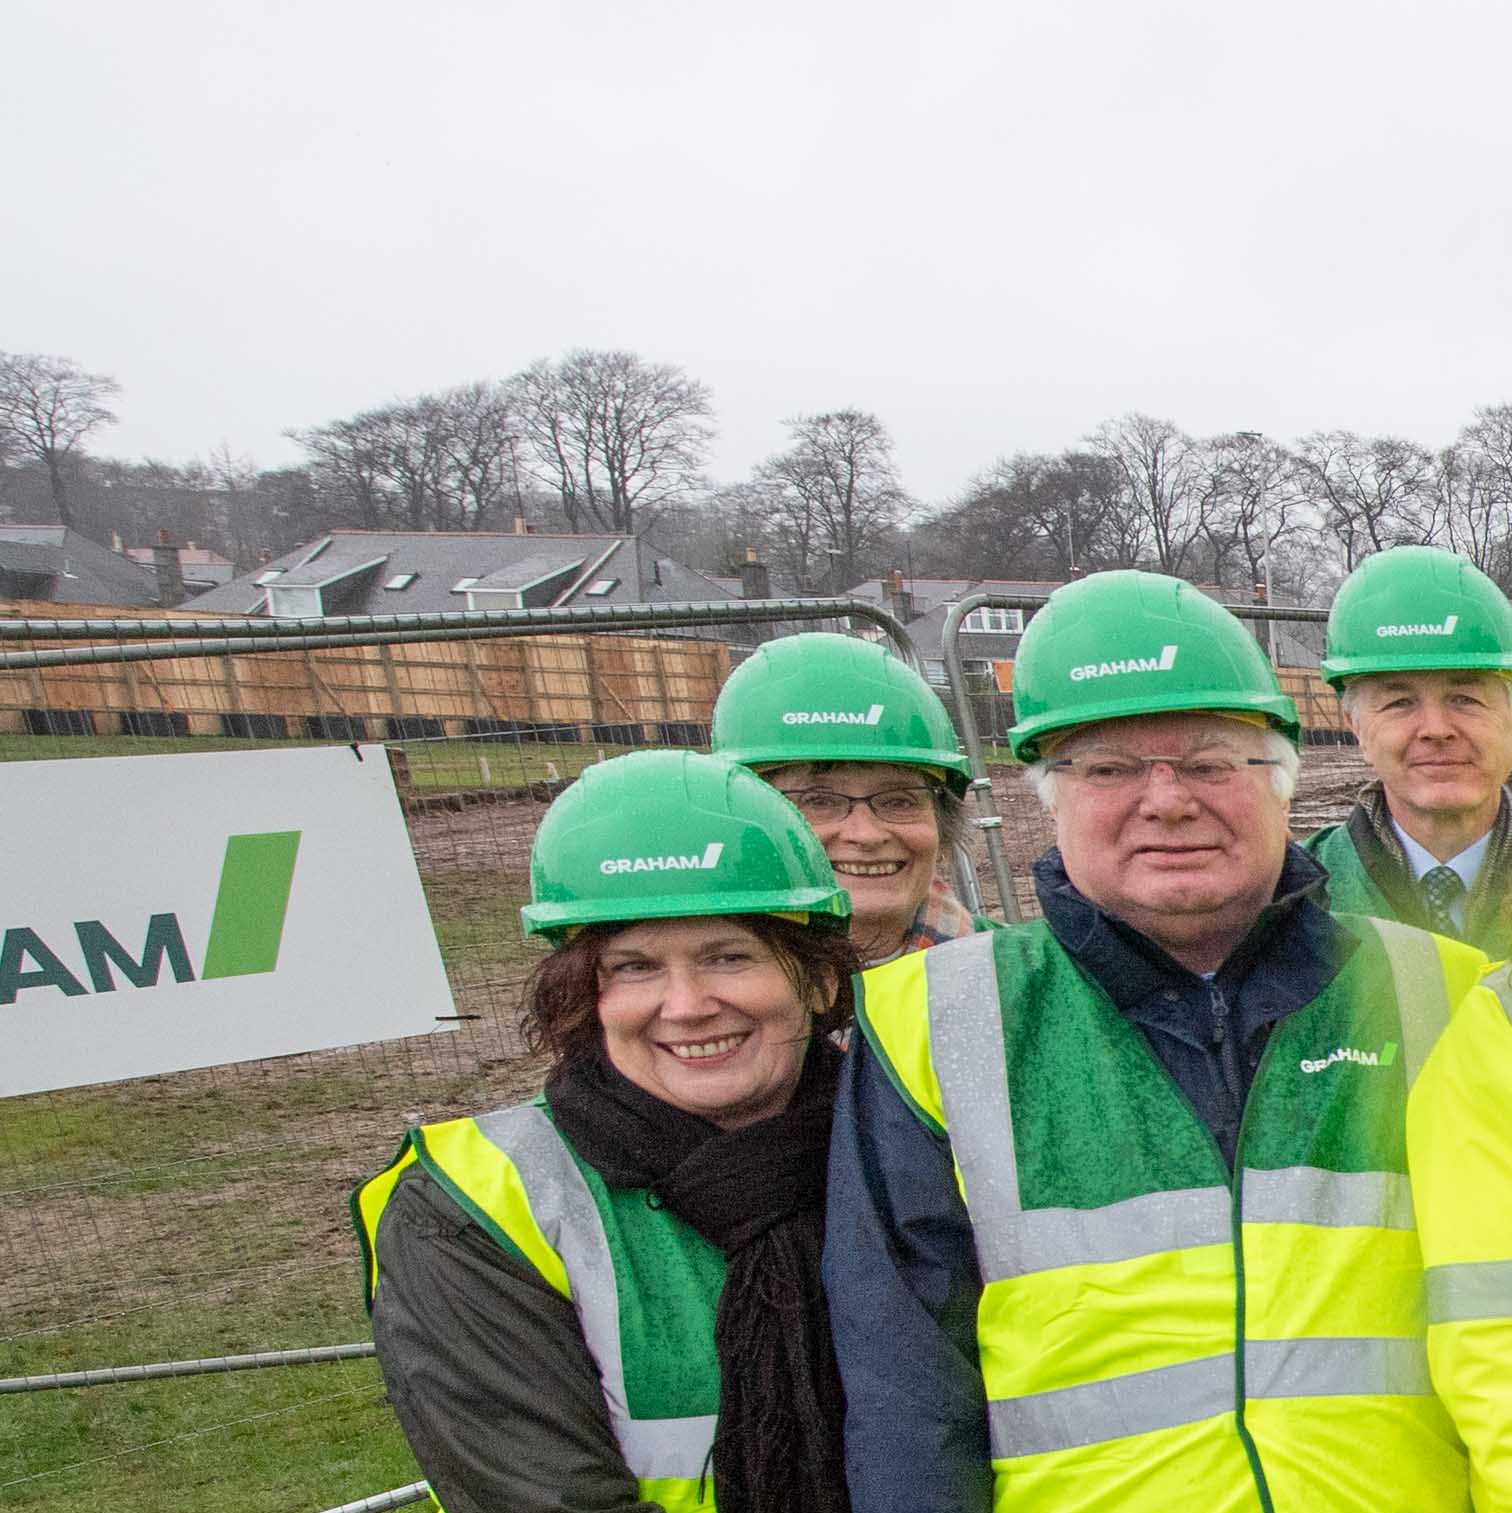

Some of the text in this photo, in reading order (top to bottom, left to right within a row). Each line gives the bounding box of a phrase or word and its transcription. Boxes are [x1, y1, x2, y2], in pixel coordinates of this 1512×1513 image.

[1377, 625, 1443, 638] GRAHAM
[1071, 657, 1161, 682] GRAHAM
[783, 712, 866, 725] GRAHAM
[600, 855, 700, 874] GRAHAM
[1300, 1047, 1379, 1074] GRAHAM
